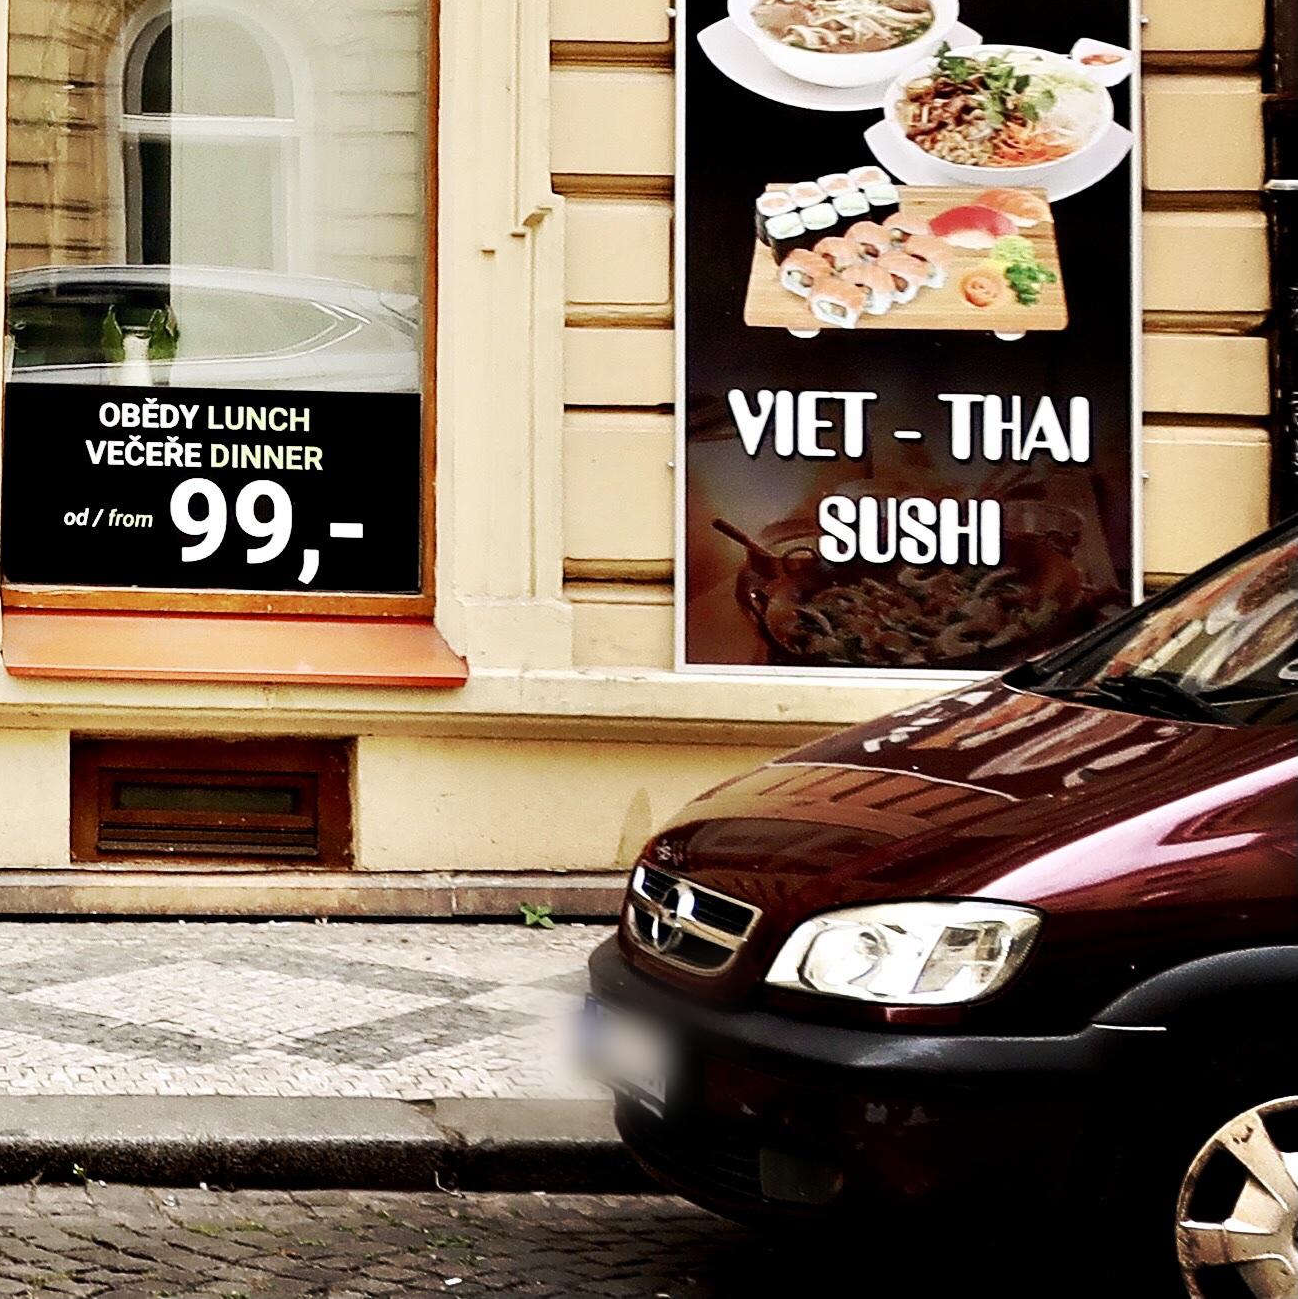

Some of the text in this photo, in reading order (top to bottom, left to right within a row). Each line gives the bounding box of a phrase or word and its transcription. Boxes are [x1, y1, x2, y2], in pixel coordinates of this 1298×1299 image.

[99, 398, 310, 432] OBĚDY LUNCH
[727, 389, 1090, 462] VIET - THAI
[85, 435, 323, 471] VEČEŘE DINNER
[63, 508, 88, 527] od
[92, 509, 103, 528] /
[108, 508, 153, 528] from
[818, 495, 1001, 566] SUSHI
